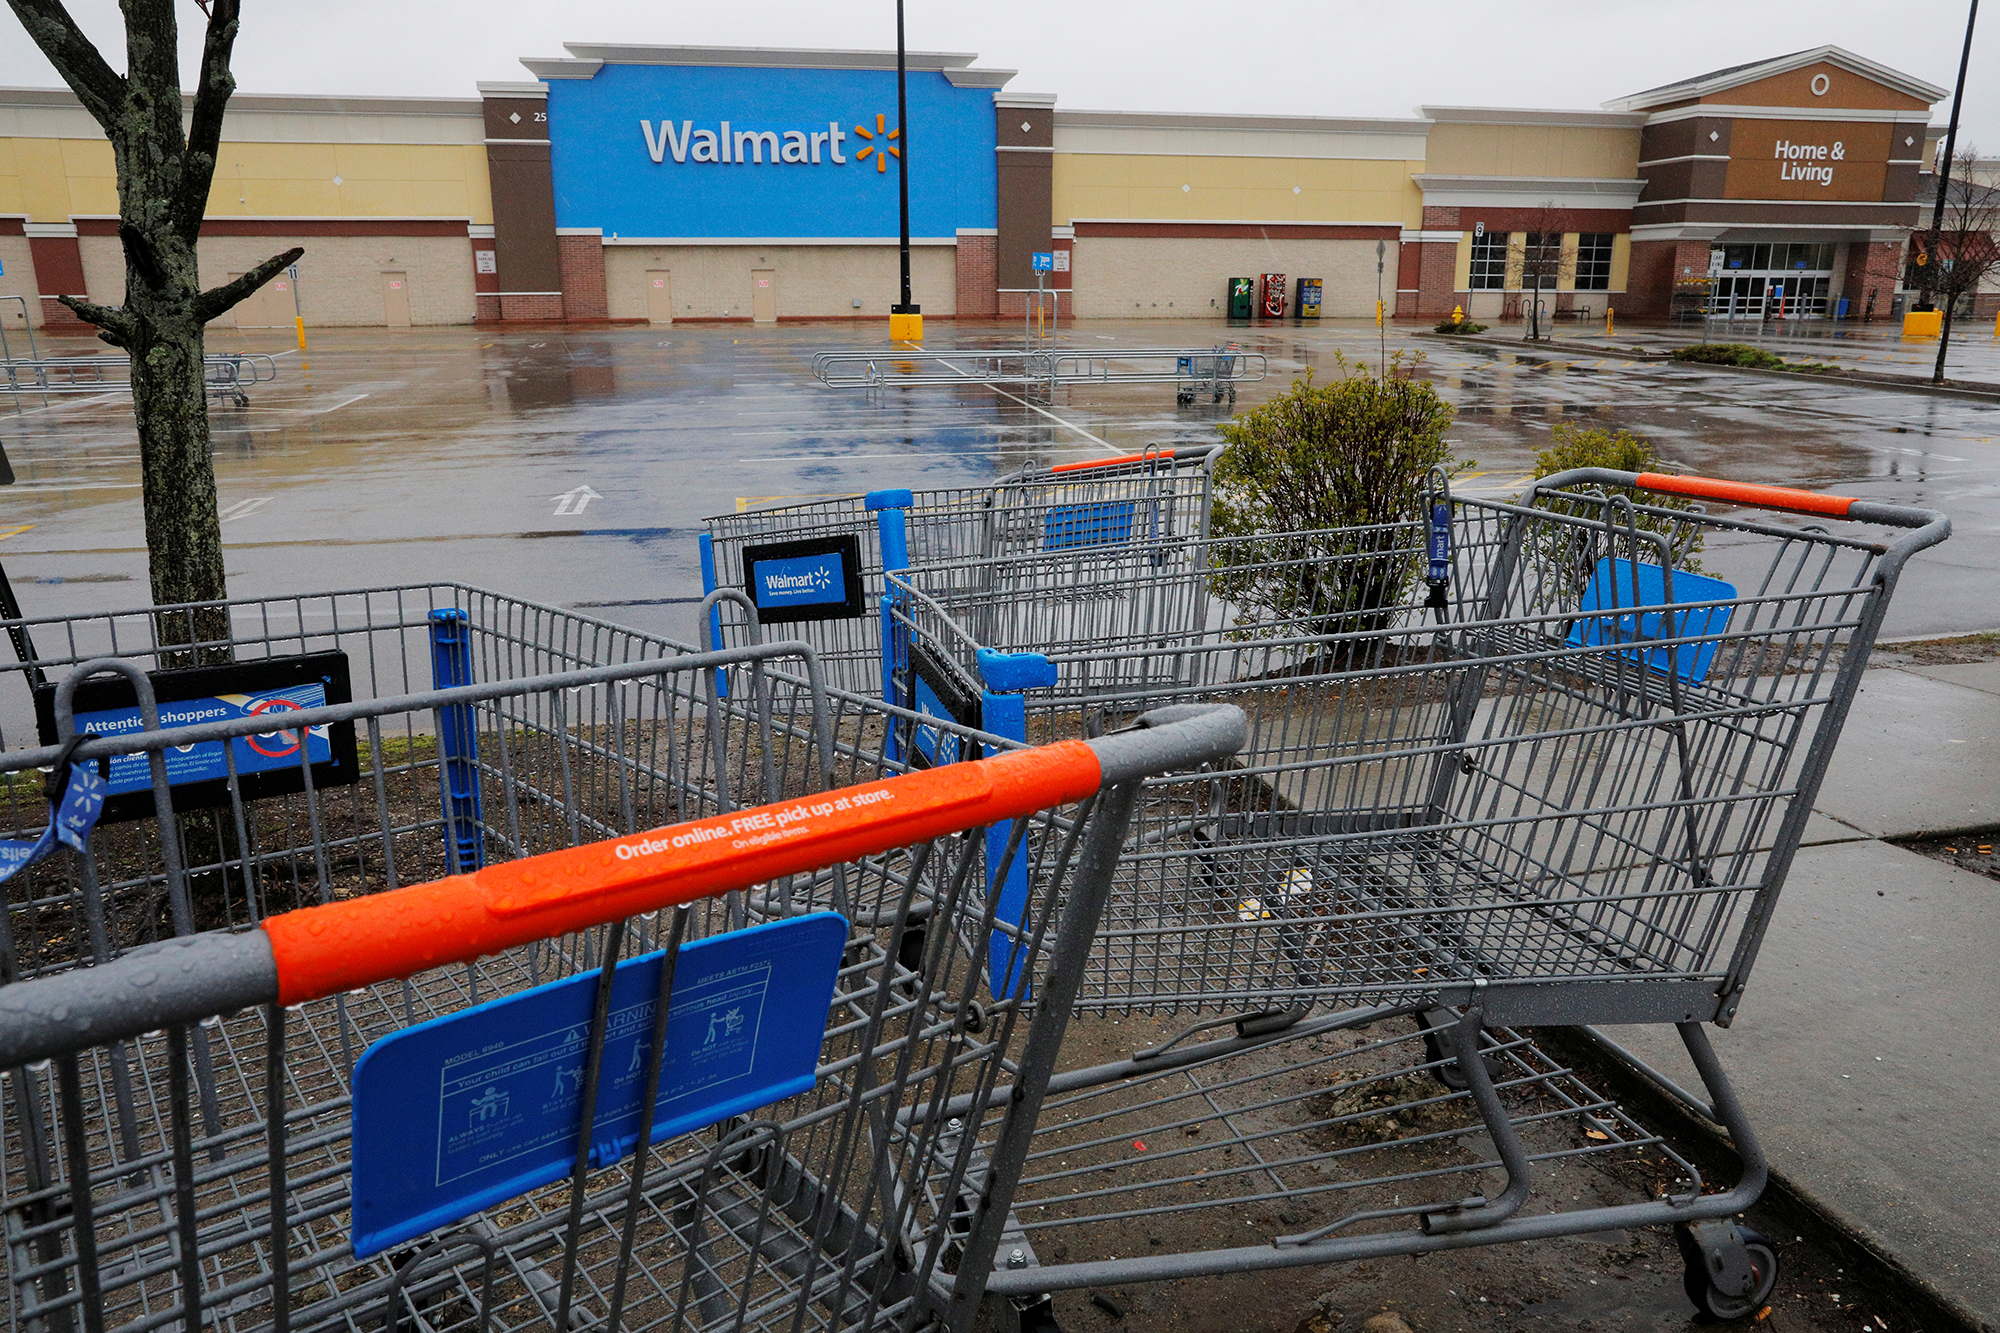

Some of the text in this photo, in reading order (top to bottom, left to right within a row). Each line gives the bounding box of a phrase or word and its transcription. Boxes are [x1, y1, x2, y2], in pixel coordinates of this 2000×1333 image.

[533, 112, 547, 122] 25
[640, 119, 847, 165] Walmart
[1774, 140, 1846, 161] Home &
[1780, 161, 1834, 186] Living
[1477, 226, 1483, 236] 9
[289, 269, 298, 279] 11
[1435, 535, 1446, 558] mart
[766, 572, 814, 589] Walmart
[160, 707, 228, 725] shoppers
[614, 789, 896, 861] Order online. FREE pick up at store.
[732, 826, 810, 851] On eligible items.
[697, 971, 725, 985] MEETS
[727, 966, 748, 978] ASTM
[584, 1002, 657, 1037] WARNIN
[457, 1075, 483, 1089] Your
[485, 1066, 510, 1081] child
[512, 1060, 531, 1071] can
[533, 1053, 549, 1066] fall
[550, 1048, 567, 1058] out
[568, 1044, 579, 1055] of
[604, 1030, 616, 1040] art
[618, 1025, 636, 1036] and
[637, 1018, 655, 1029] suff
[673, 1001, 704, 1017] serious
[706, 994, 727, 1006] head
[728, 987, 753, 1001] injury.
[702, 1042, 717, 1053] NOT
[444, 1041, 505, 1066] MODEL 6940
[625, 1071, 642, 1082] NOT
[448, 1125, 485, 1143] ALWAYS
[479, 1148, 505, 1164] ONLY
